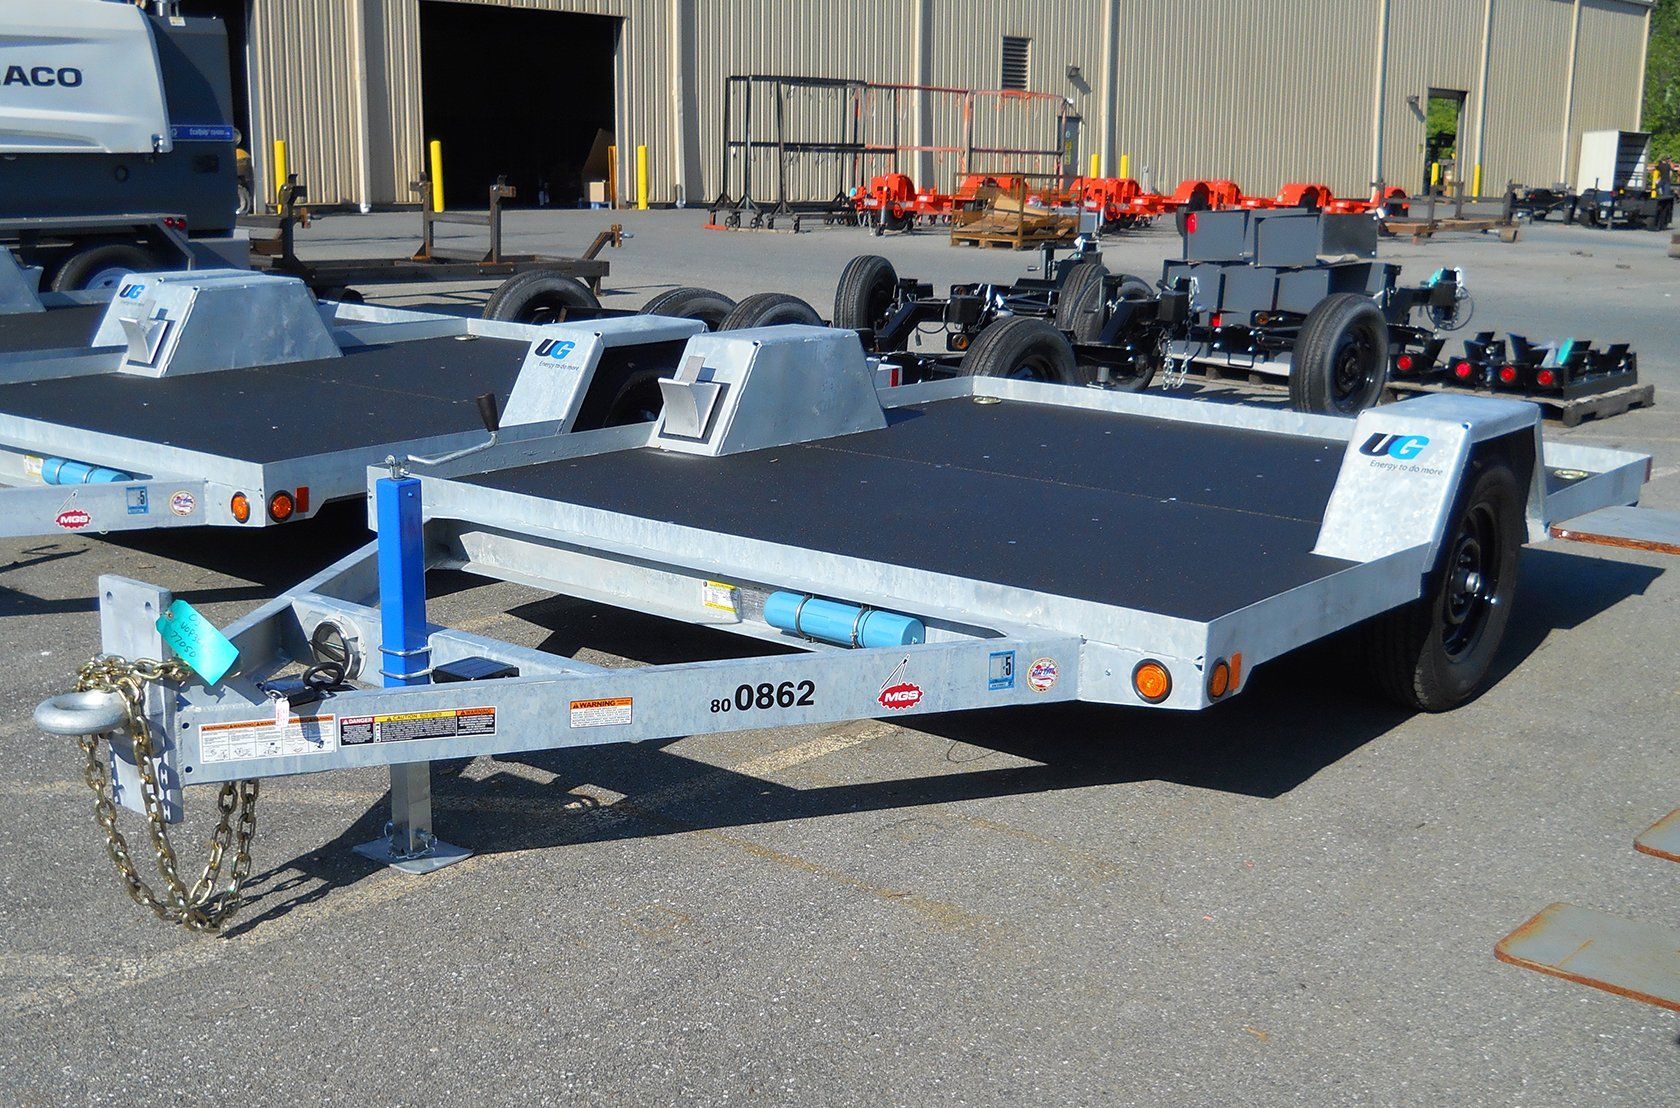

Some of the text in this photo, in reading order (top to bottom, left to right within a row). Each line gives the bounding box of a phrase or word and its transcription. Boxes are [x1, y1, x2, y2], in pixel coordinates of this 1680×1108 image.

[0, 65, 83, 88] ACO
[119, 284, 145, 299] UG
[534, 338, 576, 360] UG
[1358, 432, 1430, 460] UG
[1369, 460, 1398, 472] Energy
[1409, 464, 1420, 473] do
[1420, 467, 1443, 476] more
[60, 515, 89, 525] MGS
[1004, 656, 1012, 676] 5
[710, 680, 816, 713] 80 0862
[884, 690, 919, 702] MGS
[580, 700, 616, 709] WARNING
[348, 717, 374, 725] DANGER
